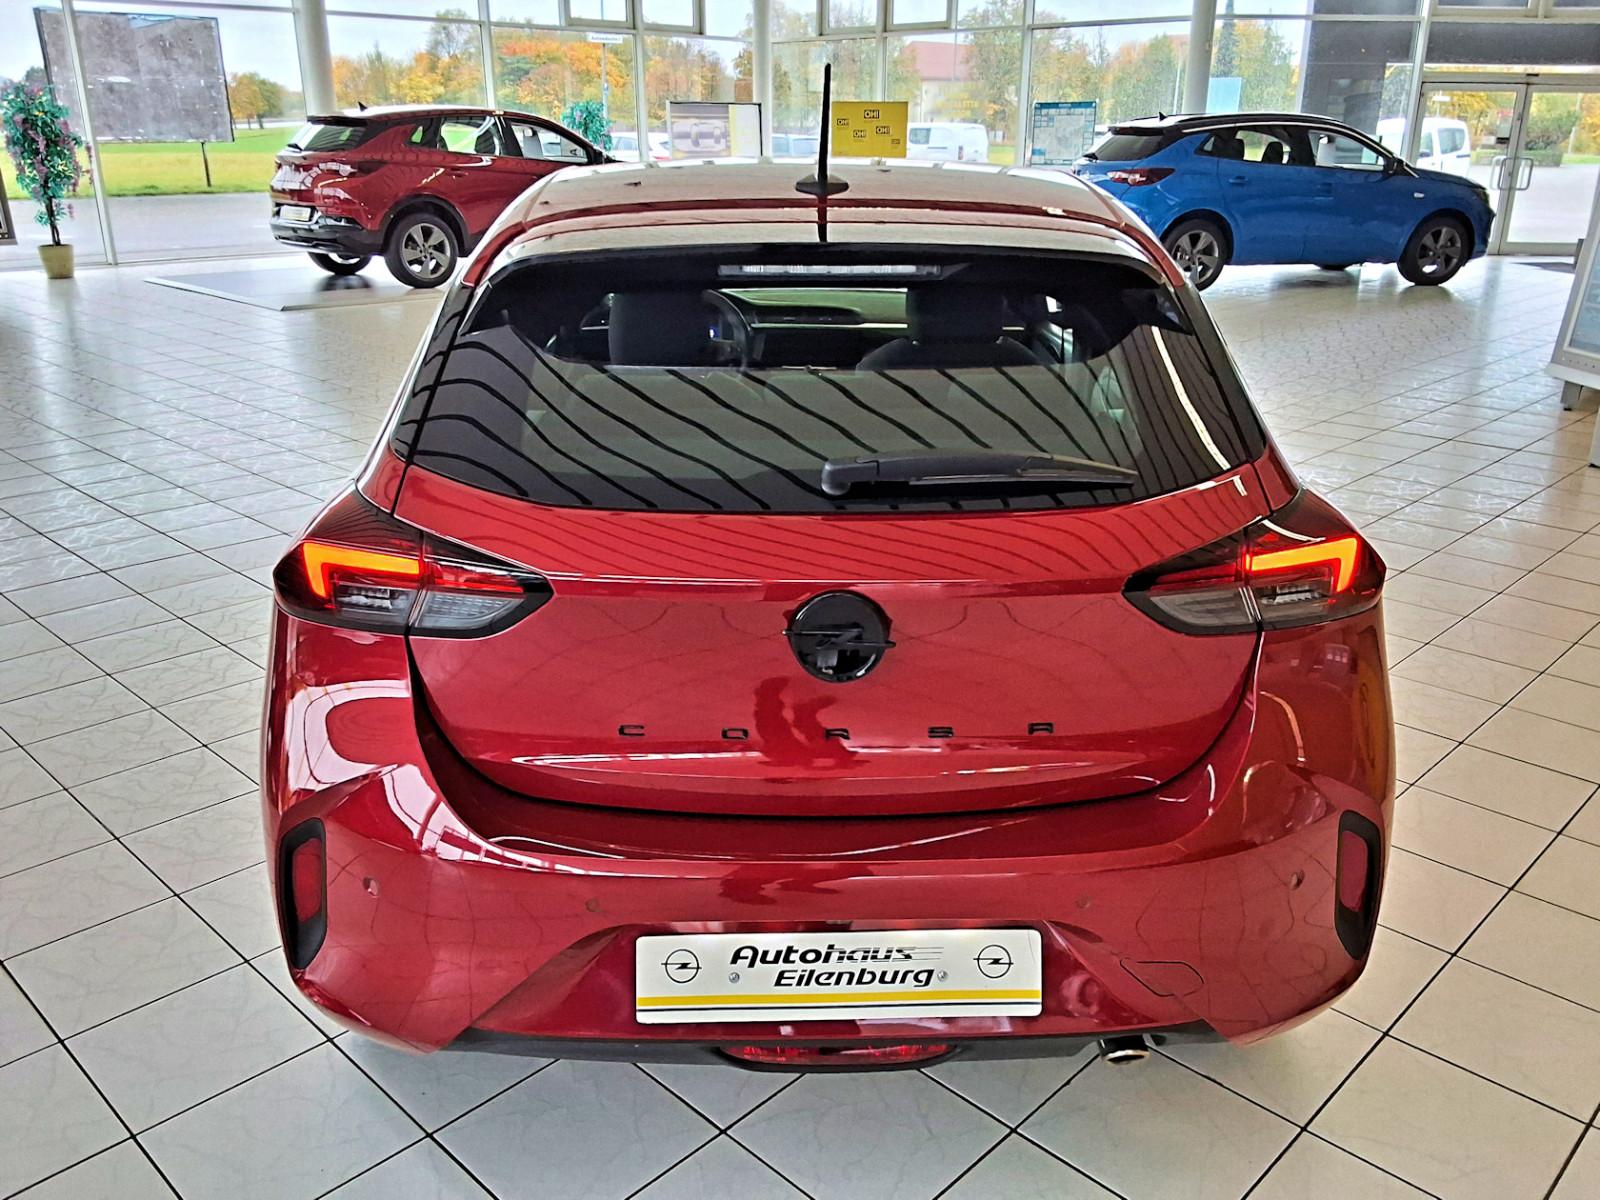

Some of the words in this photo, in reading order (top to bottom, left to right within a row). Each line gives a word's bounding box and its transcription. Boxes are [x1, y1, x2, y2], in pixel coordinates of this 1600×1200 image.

[618, 722, 1054, 740] CORSA
[729, 944, 917, 968] Autohaus
[774, 968, 935, 987] Eilenburg
